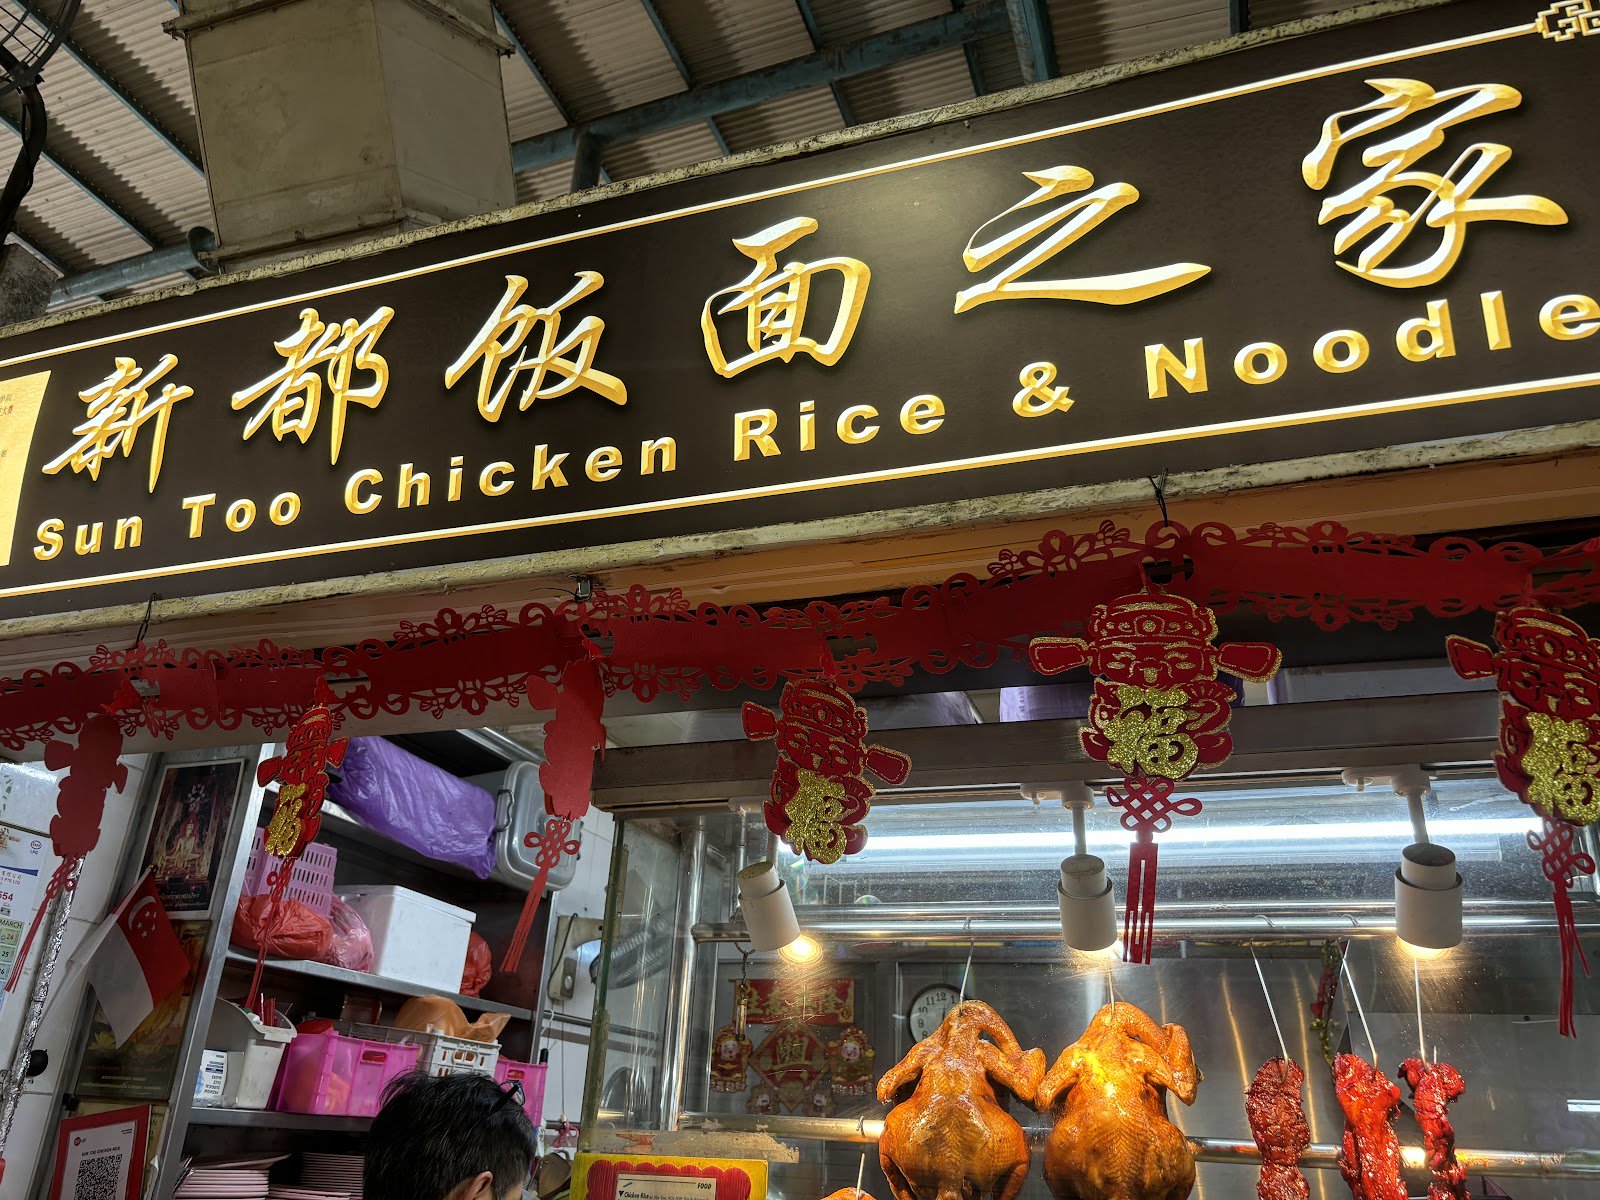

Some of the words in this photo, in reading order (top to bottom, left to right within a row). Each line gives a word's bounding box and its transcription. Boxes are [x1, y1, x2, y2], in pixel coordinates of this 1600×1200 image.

[42, 78, 1569, 493] 新都饭面之家
[33, 515, 143, 561] Sun
[181, 491, 302, 539] Too
[344, 435, 678, 514] Chicken
[733, 393, 947, 462] Rice
[1011, 360, 1074, 418] &
[1143, 290, 1600, 400] Noodle
[926, 996, 935, 1006] 11
[936, 992, 947, 1002] 12
[917, 1018, 924, 1028] 9
[697, 1182, 712, 1190] FOOD
